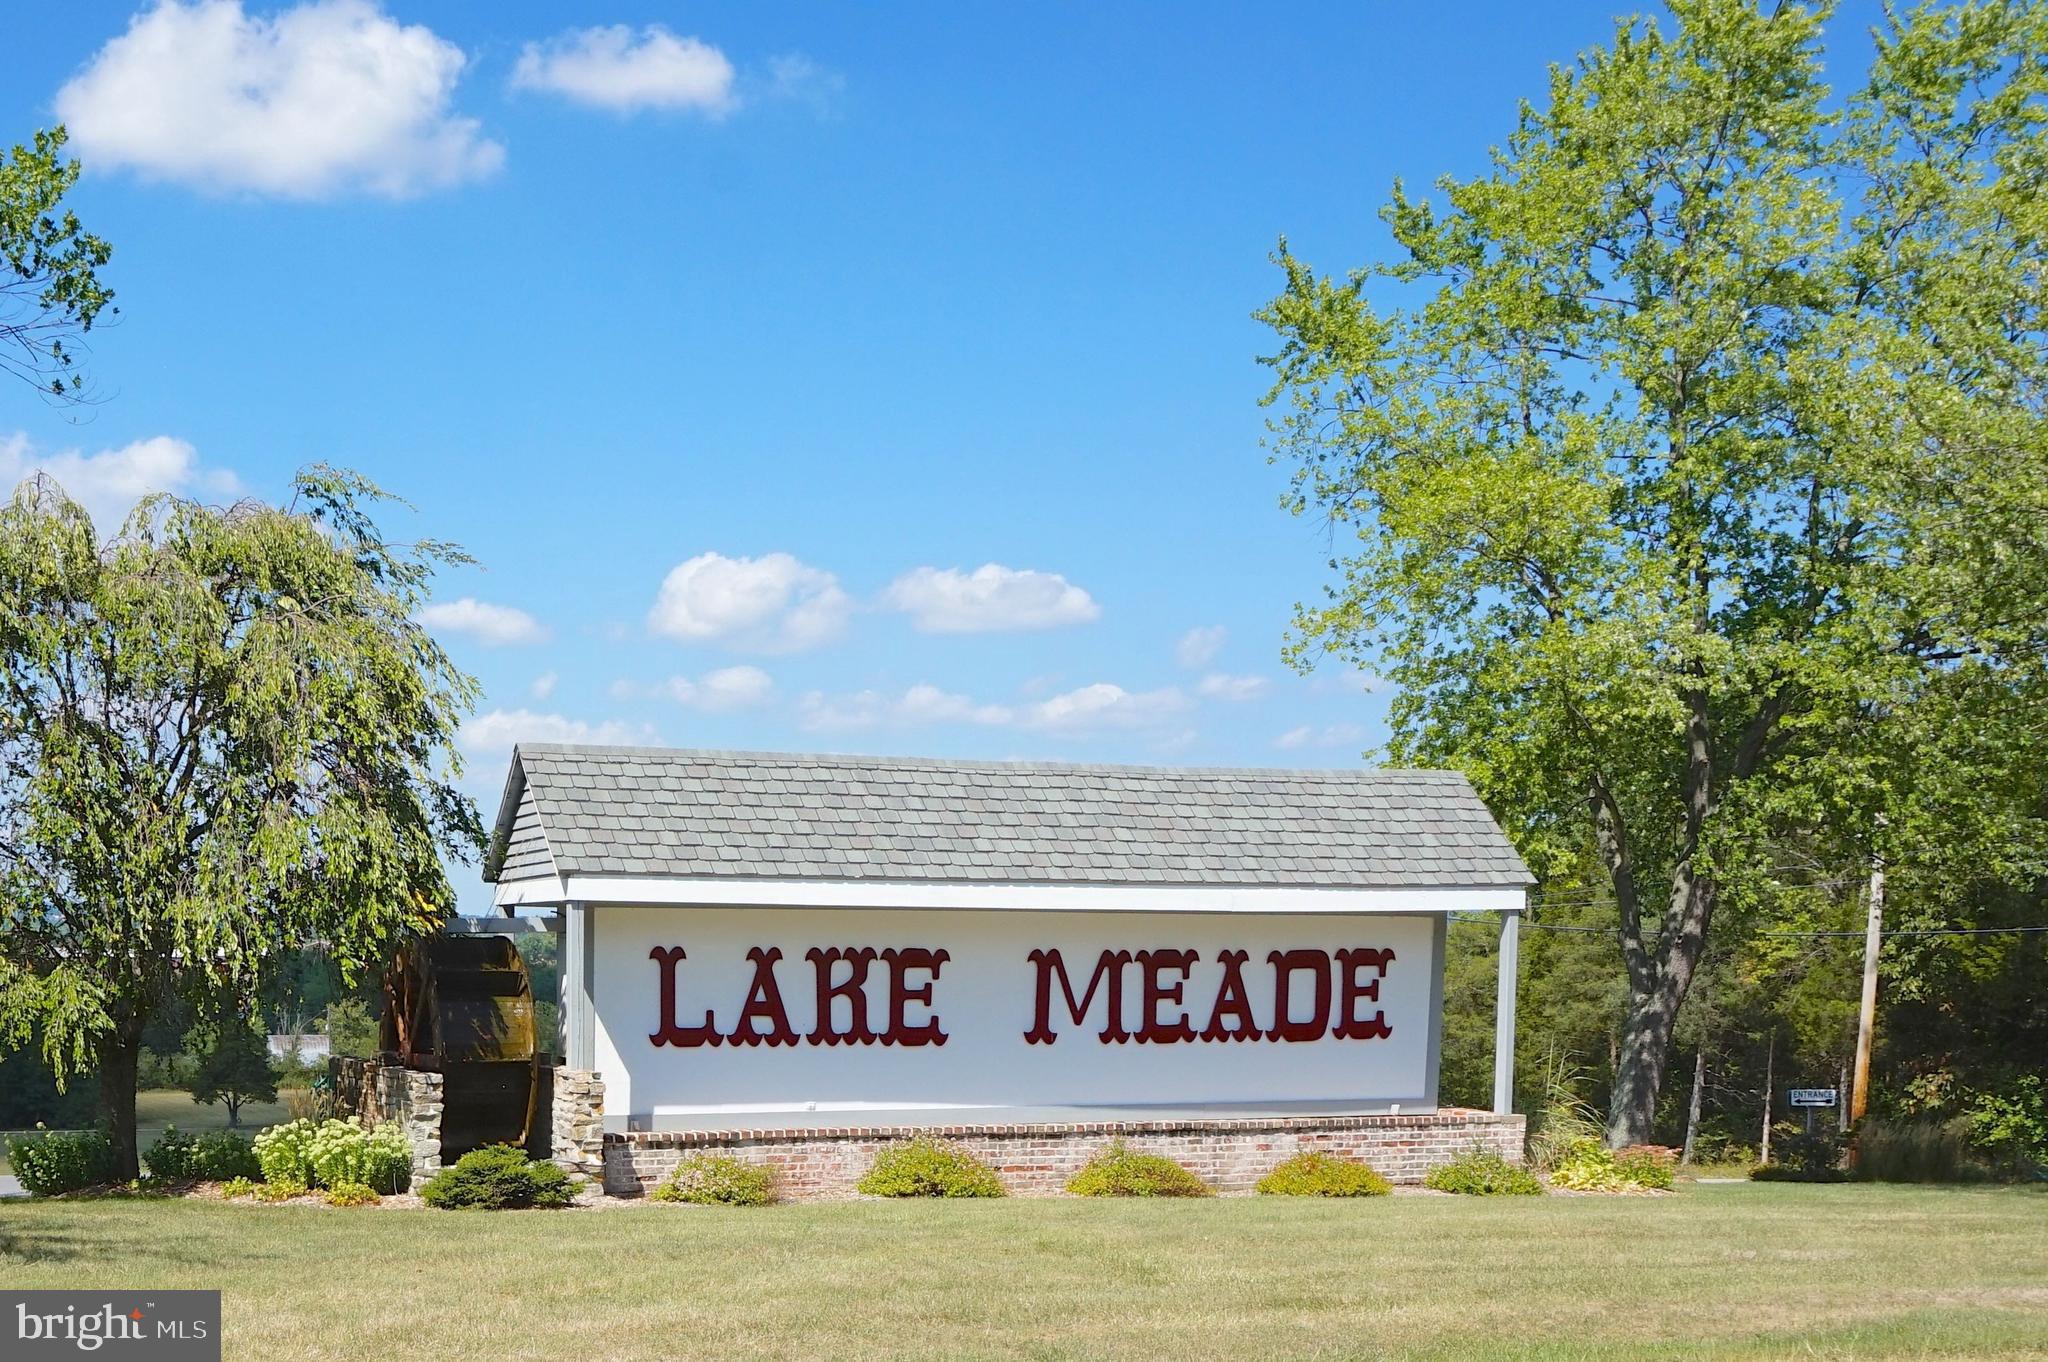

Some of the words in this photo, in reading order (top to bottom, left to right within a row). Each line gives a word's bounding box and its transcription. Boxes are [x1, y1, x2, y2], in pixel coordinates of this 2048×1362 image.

[648, 945, 952, 1049] LAKE
[1022, 947, 1397, 1046] MEADE
[1793, 1090, 1834, 1099] ENTRANCE
